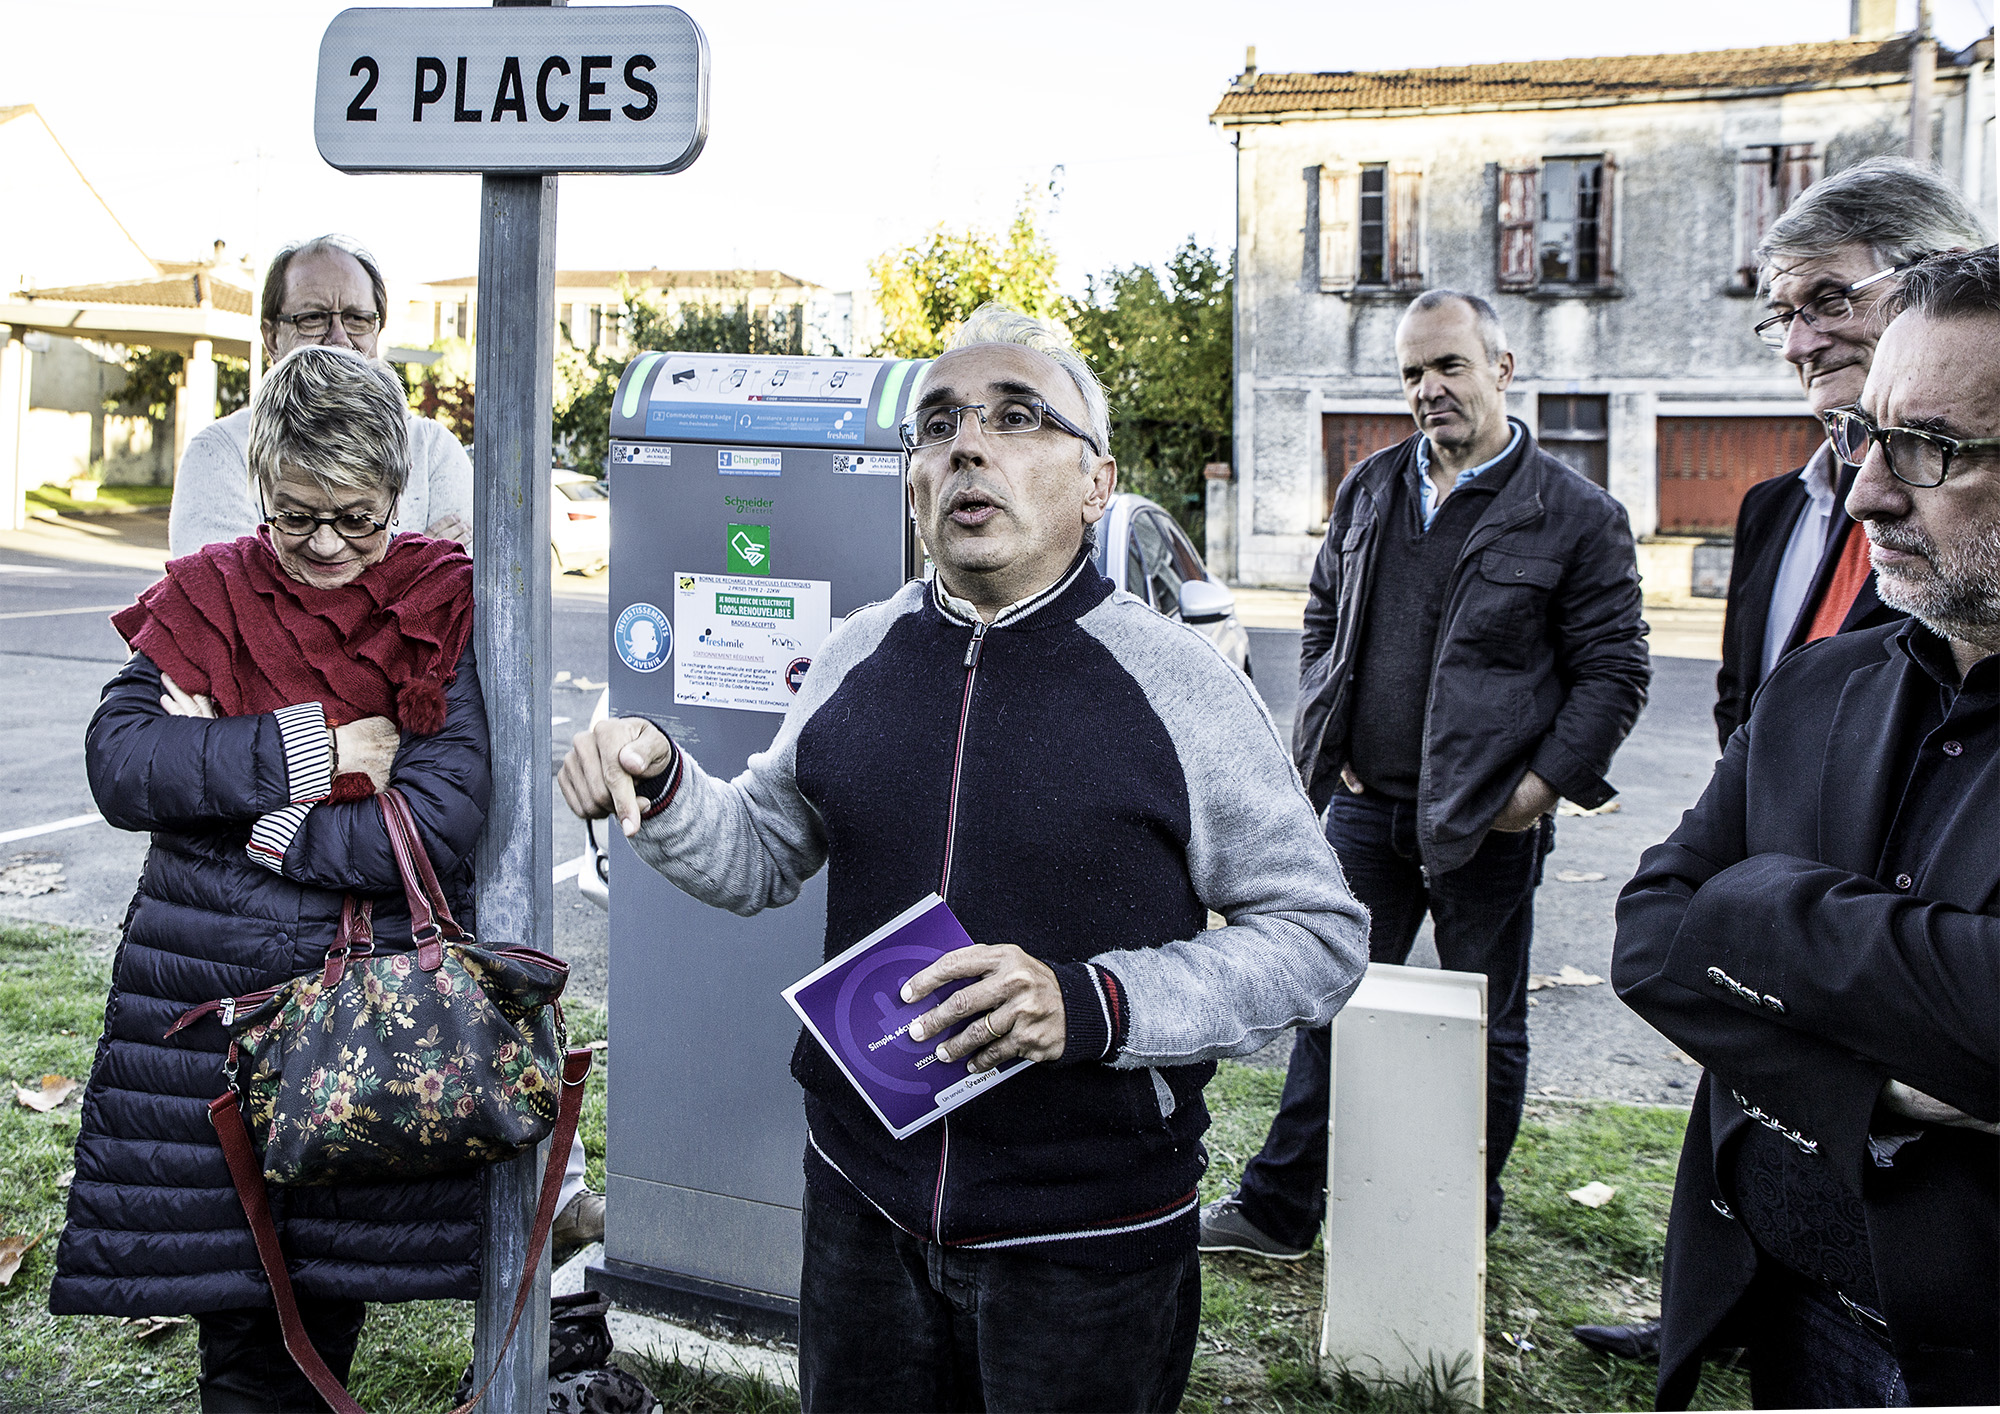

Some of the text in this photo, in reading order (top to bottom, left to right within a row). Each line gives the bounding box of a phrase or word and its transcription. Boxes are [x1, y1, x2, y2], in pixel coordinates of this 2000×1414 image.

[346, 54, 659, 123] 2 PLACES
[666, 411, 698, 419] Commandez
[827, 431, 858, 440] freshmile
[733, 455, 780, 466] Chargemap
[725, 496, 774, 508] Schneider
[754, 579, 779, 587] VÉHICULES
[780, 580, 811, 588] ÉLECTRIQUES
[725, 596, 739, 604] ROULE
[759, 598, 791, 607] L'ÉLECTRICITÉ
[719, 604, 791, 618] 100% RENOUVELABLE
[617, 606, 670, 637] INVESTISSEMENTS
[751, 621, 776, 629] ACCEPTÉS
[706, 636, 744, 648] freshmile
[693, 651, 732, 659] STATIONNEMENT
[626, 655, 661, 669] D'AVENIR
[868, 1034, 897, 1052] Simple,
[950, 1088, 965, 1098] service
[974, 1070, 997, 1086] easytrip
